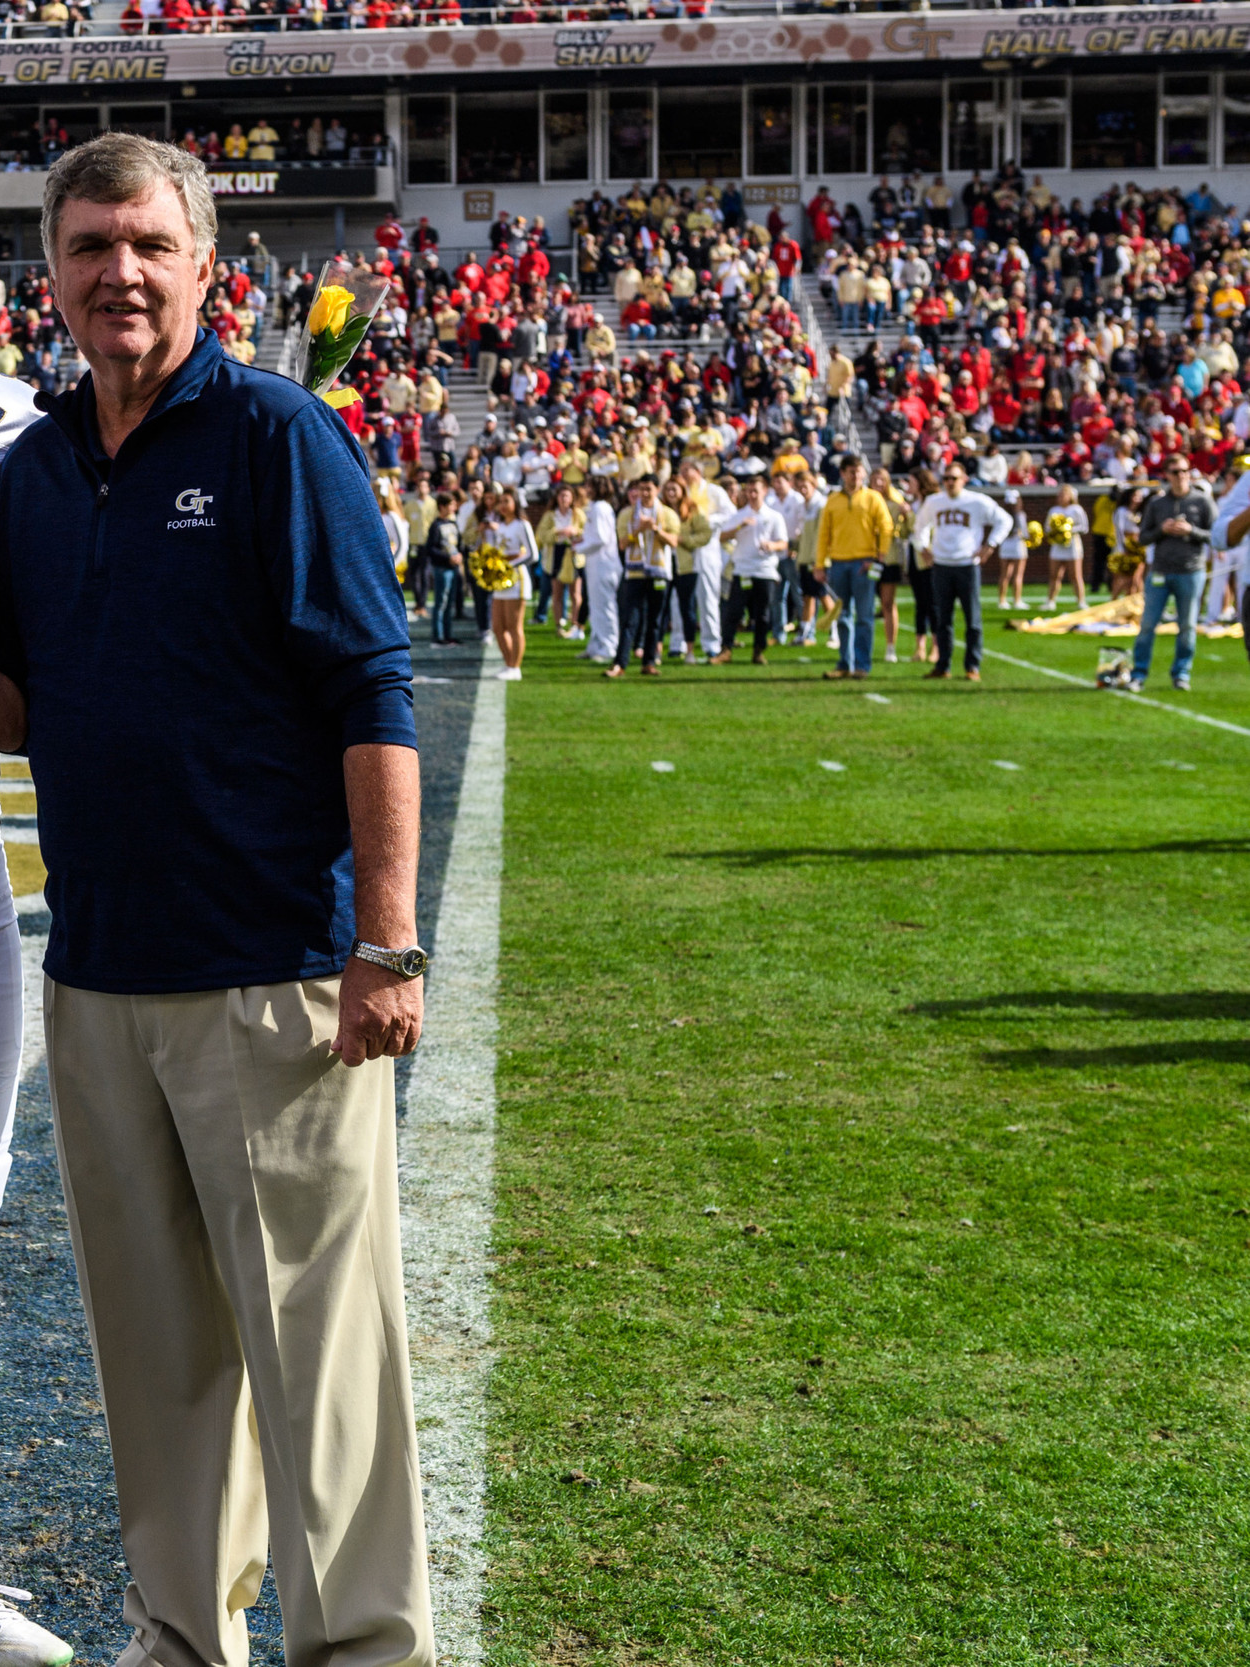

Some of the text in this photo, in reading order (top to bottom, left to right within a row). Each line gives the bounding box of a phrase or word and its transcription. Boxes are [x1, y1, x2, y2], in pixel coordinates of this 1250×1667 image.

[1017, 10, 1218, 27] COLLEGE FOOTBALL
[70, 39, 165, 54] FOOTBALL
[226, 40, 265, 55] JOE
[554, 29, 611, 46] BILLY
[983, 23, 1250, 56] HALL OF FAME
[227, 53, 335, 77] GUYON
[555, 43, 654, 67] SHAW
[15, 58, 61, 83] OF
[69, 55, 168, 81] FAME
[175, 488, 214, 515] GT
[167, 517, 217, 530] FOOTBALL
[936, 508, 971, 528] TECH
